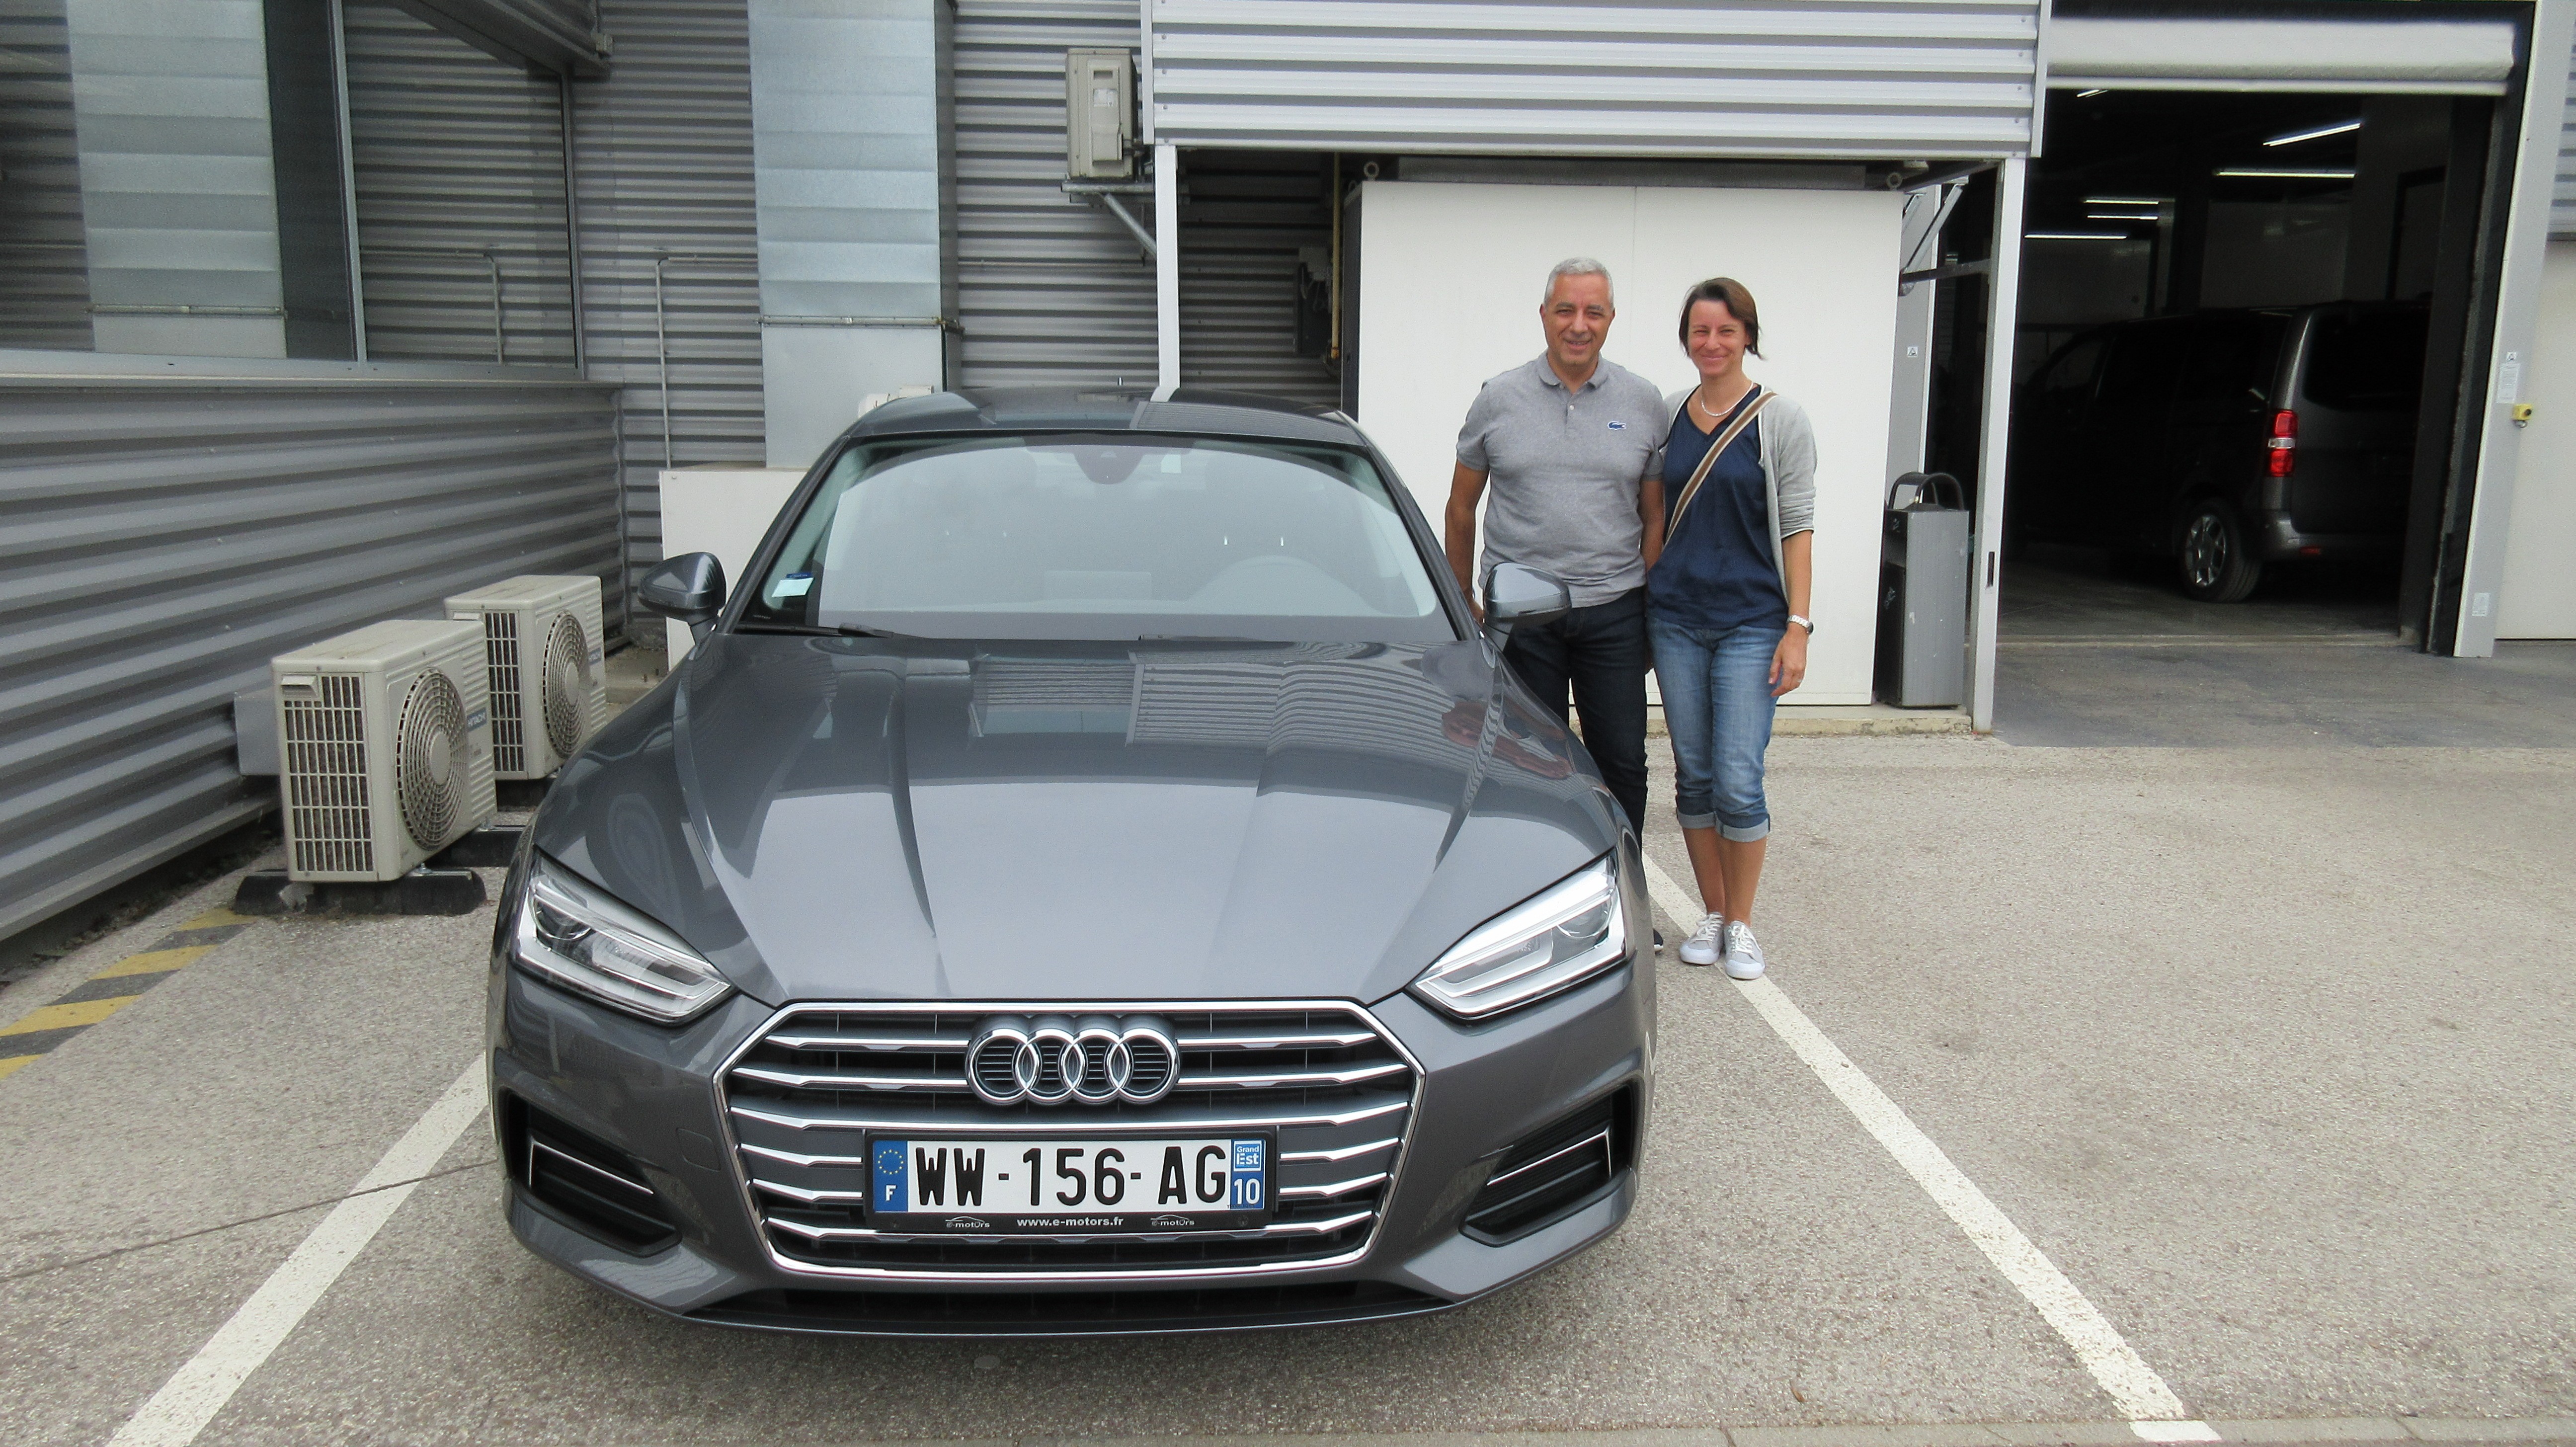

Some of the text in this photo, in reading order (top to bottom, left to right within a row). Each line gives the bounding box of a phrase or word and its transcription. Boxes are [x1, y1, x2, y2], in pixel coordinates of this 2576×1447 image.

[1236, 1153, 1259, 1165] Est
[886, 1185, 896, 1201] F
[1234, 1178, 1260, 1205] 10
[1017, 1216, 1124, 1226] www.e-motors.fr
